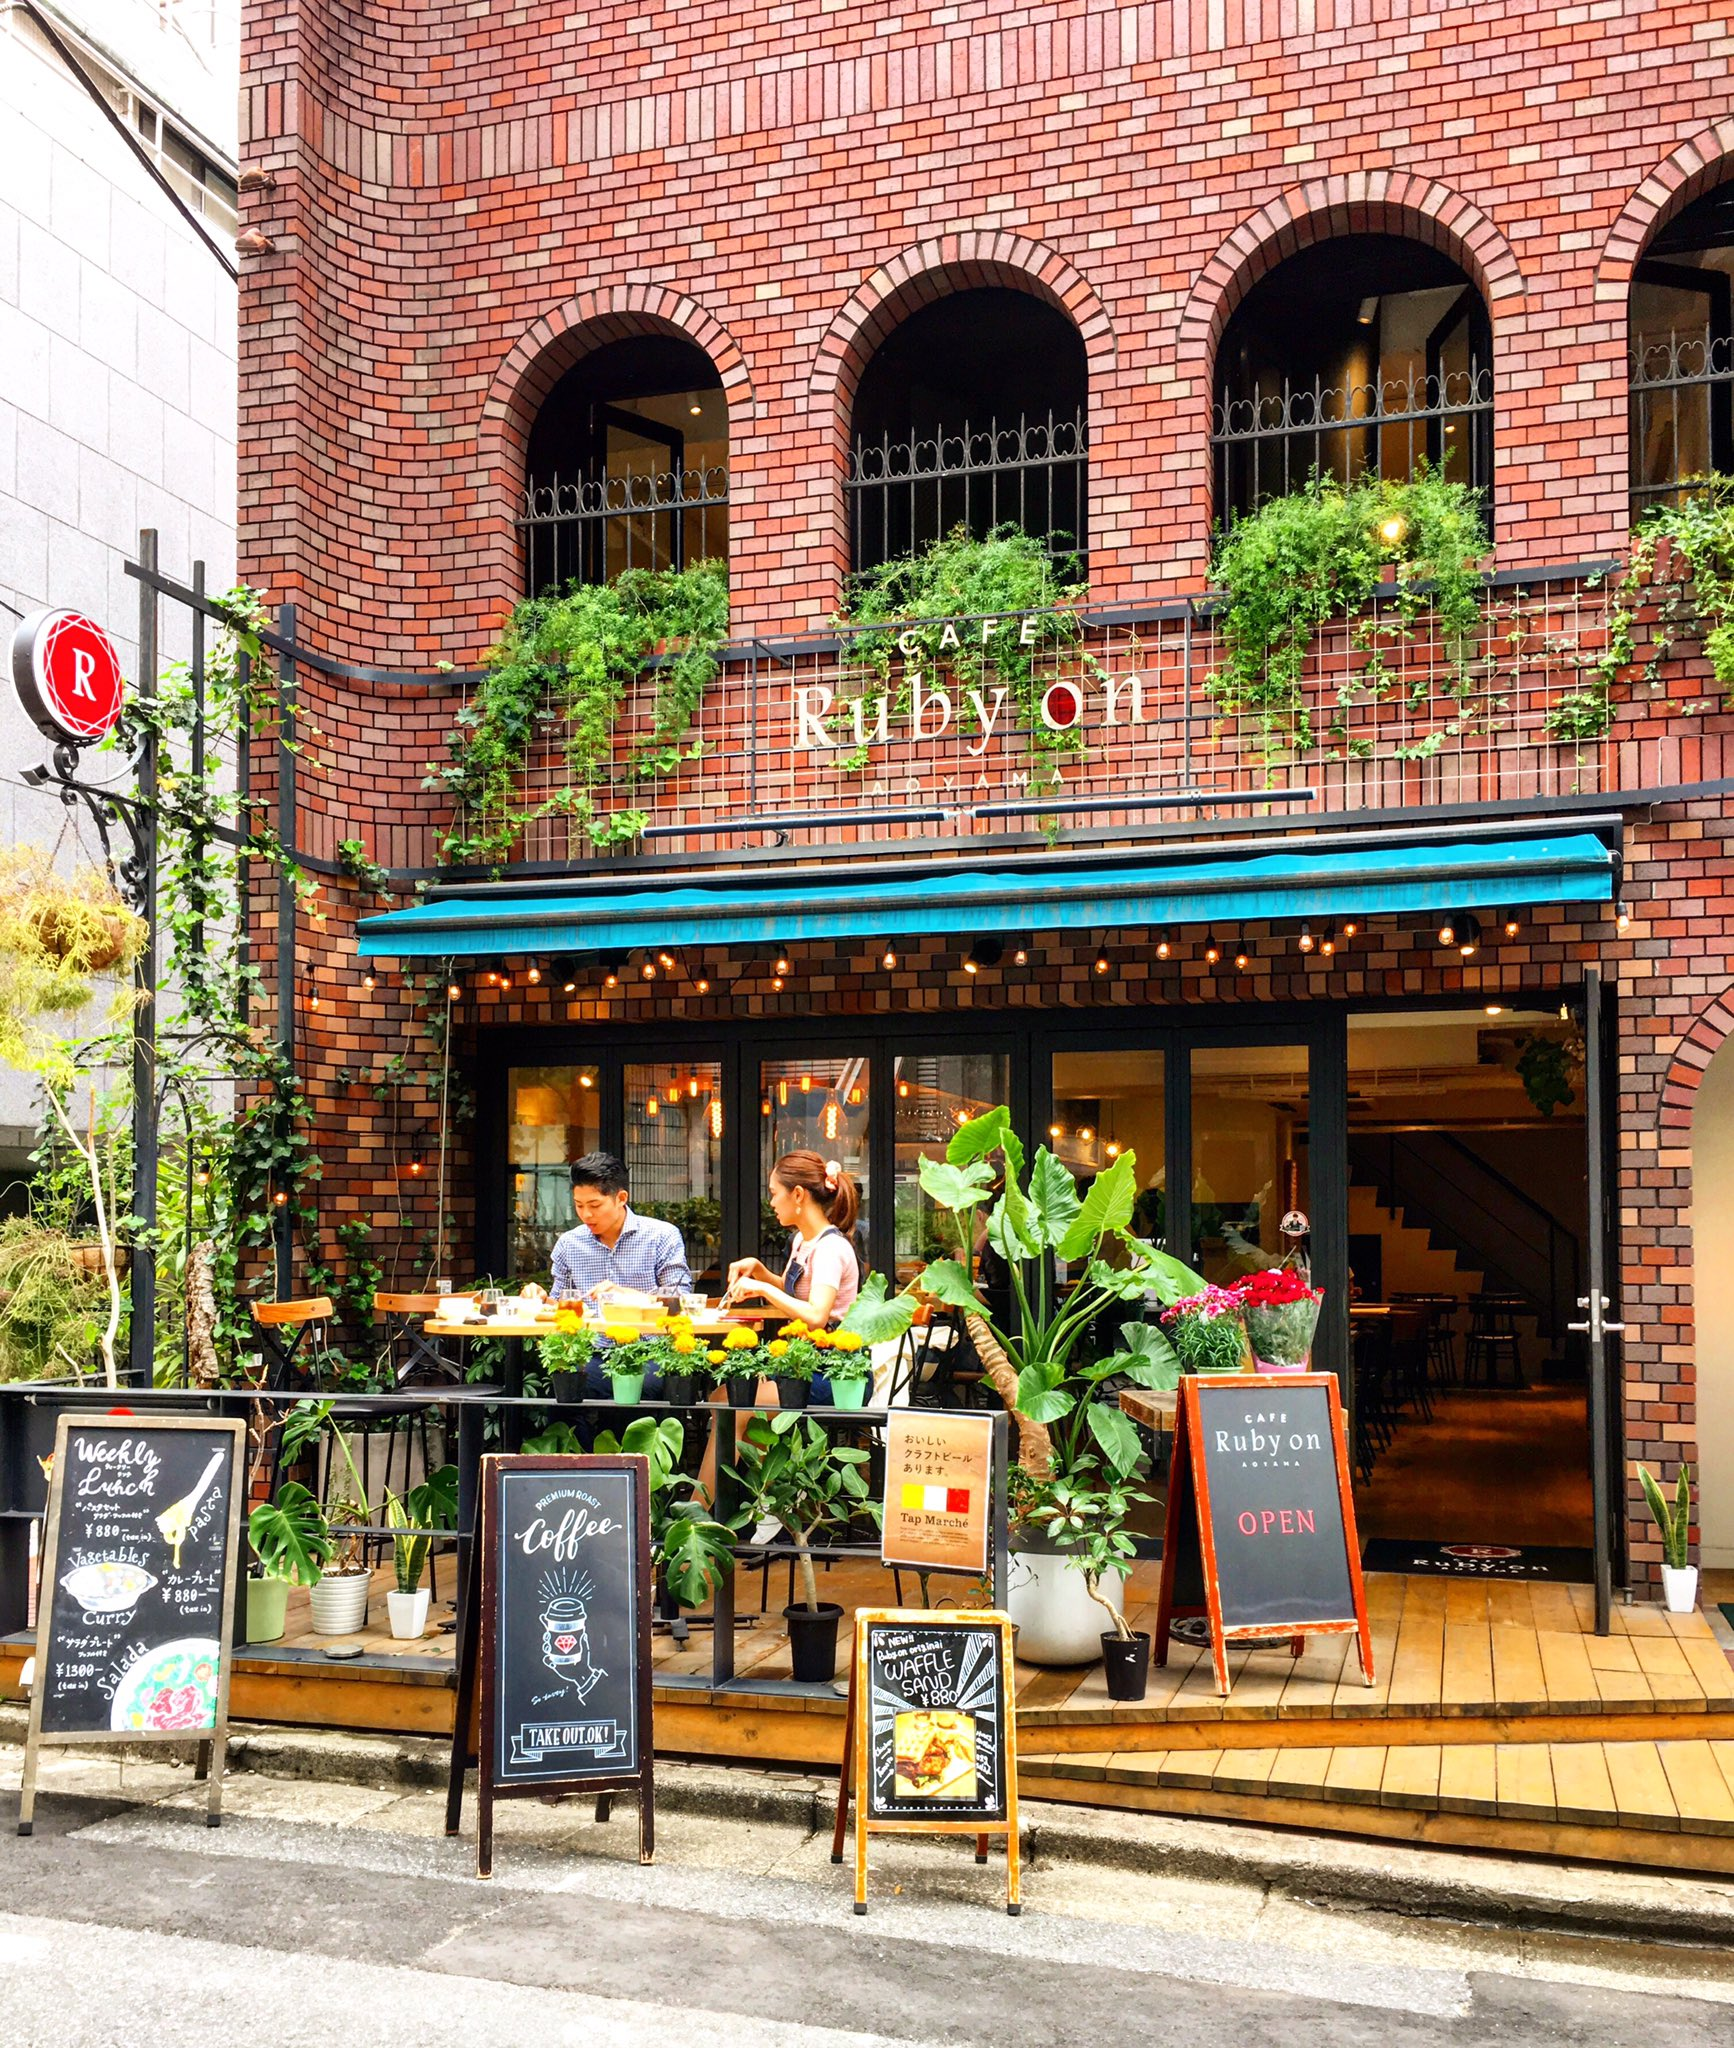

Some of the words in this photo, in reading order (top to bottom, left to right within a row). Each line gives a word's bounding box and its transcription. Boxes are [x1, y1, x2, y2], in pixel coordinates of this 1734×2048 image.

[899, 619, 1037, 654] CAFE
[72, 648, 96, 701] R
[793, 672, 1009, 756] Ruby
[1040, 676, 1148, 731] on
[872, 769, 1065, 796] AOYAMA
[1245, 1413, 1287, 1424] CAFE
[904, 1434, 947, 1447] おいしい
[1215, 1429, 1280, 1457] Ruby
[1289, 1433, 1321, 1451] on
[74, 1437, 161, 1474] Weekly
[904, 1449, 972, 1464] クラフトビール
[1242, 1460, 1300, 1468] AOYAMA
[78, 1467, 159, 1497] Lunch
[903, 1463, 949, 1477] あります。
[535, 1489, 575, 1511] PREMIUM
[576, 1490, 601, 1509] ROAST
[900, 1513, 922, 1525] Tap
[925, 1514, 969, 1529] Marché
[1238, 1510, 1316, 1536] OPEN
[514, 1509, 622, 1562] Coffee
[82, 1609, 136, 1625] Curry
[97, 1641, 149, 1700] Salada
[884, 1650, 955, 1680] WAFFLE
[901, 1672, 952, 1697] SAND
[920, 1689, 958, 1707] ¥880
[529, 1727, 561, 1747] TAKE
